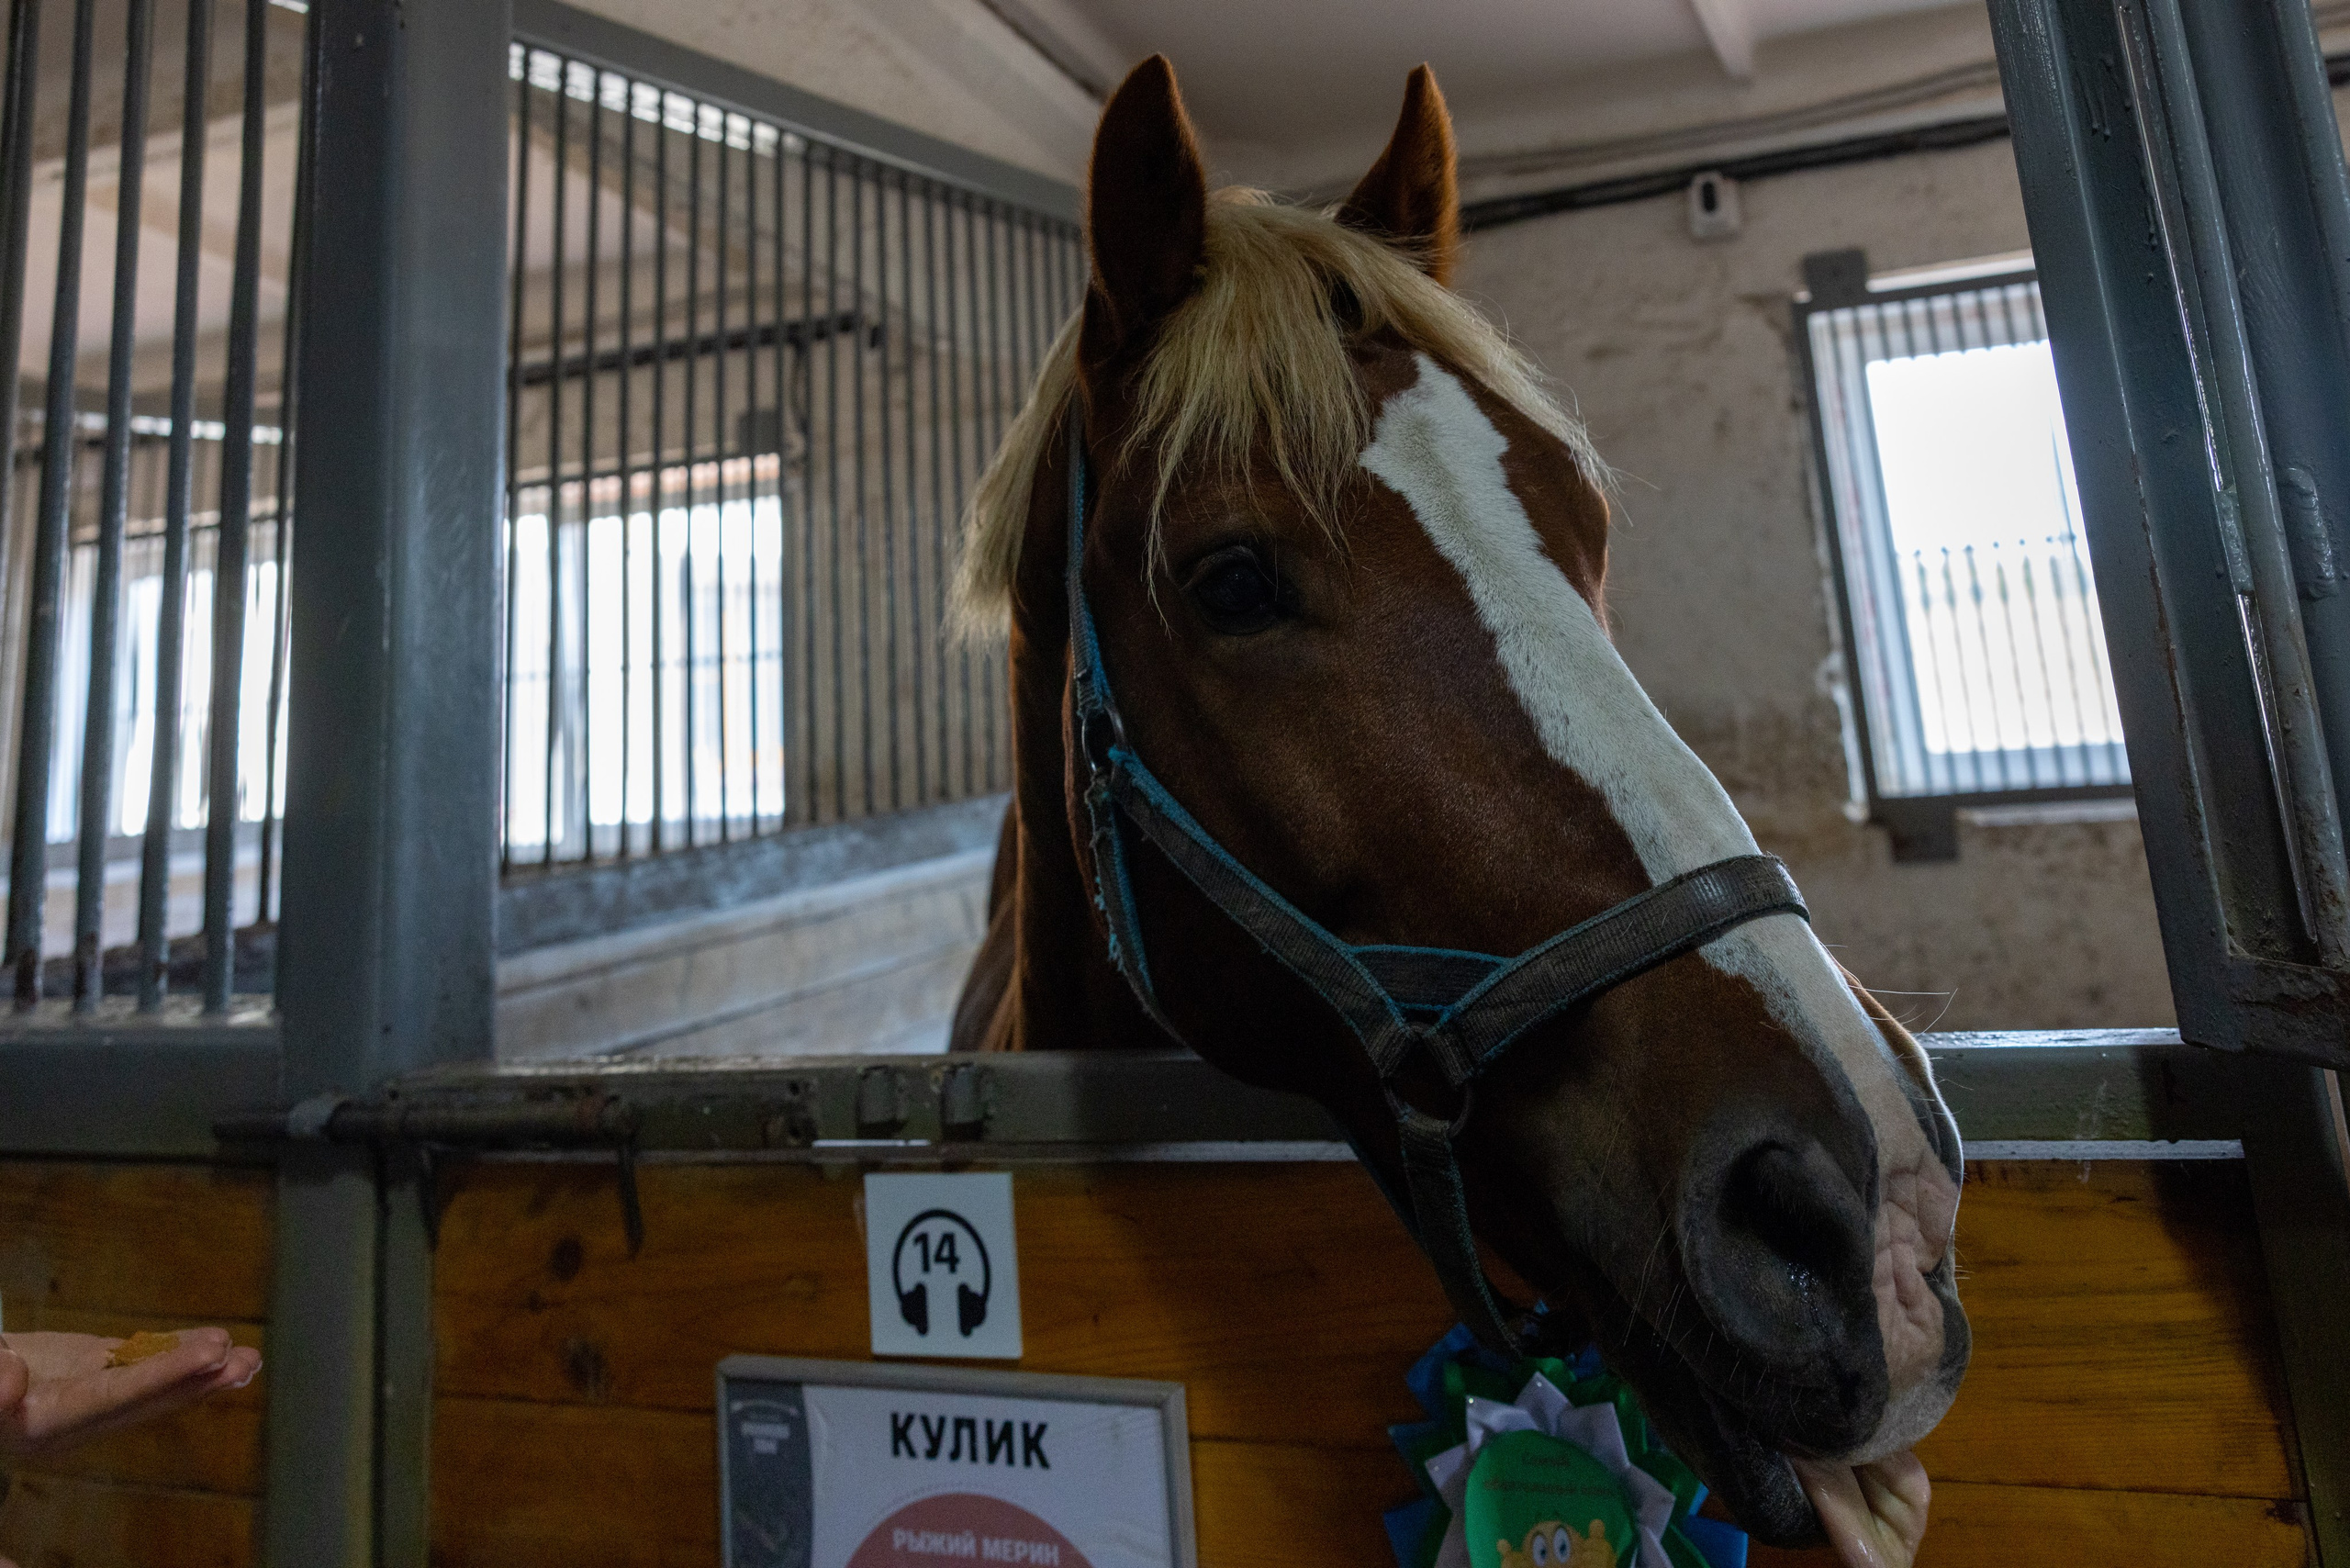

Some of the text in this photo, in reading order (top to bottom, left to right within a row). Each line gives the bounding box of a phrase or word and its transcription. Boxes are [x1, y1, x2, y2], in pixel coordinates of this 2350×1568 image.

[912, 1232, 960, 1273] 14
[891, 1412, 1050, 1469] КУЛИК
[892, 1527, 1059, 1566] РЫЖИЙ МЕРИН
